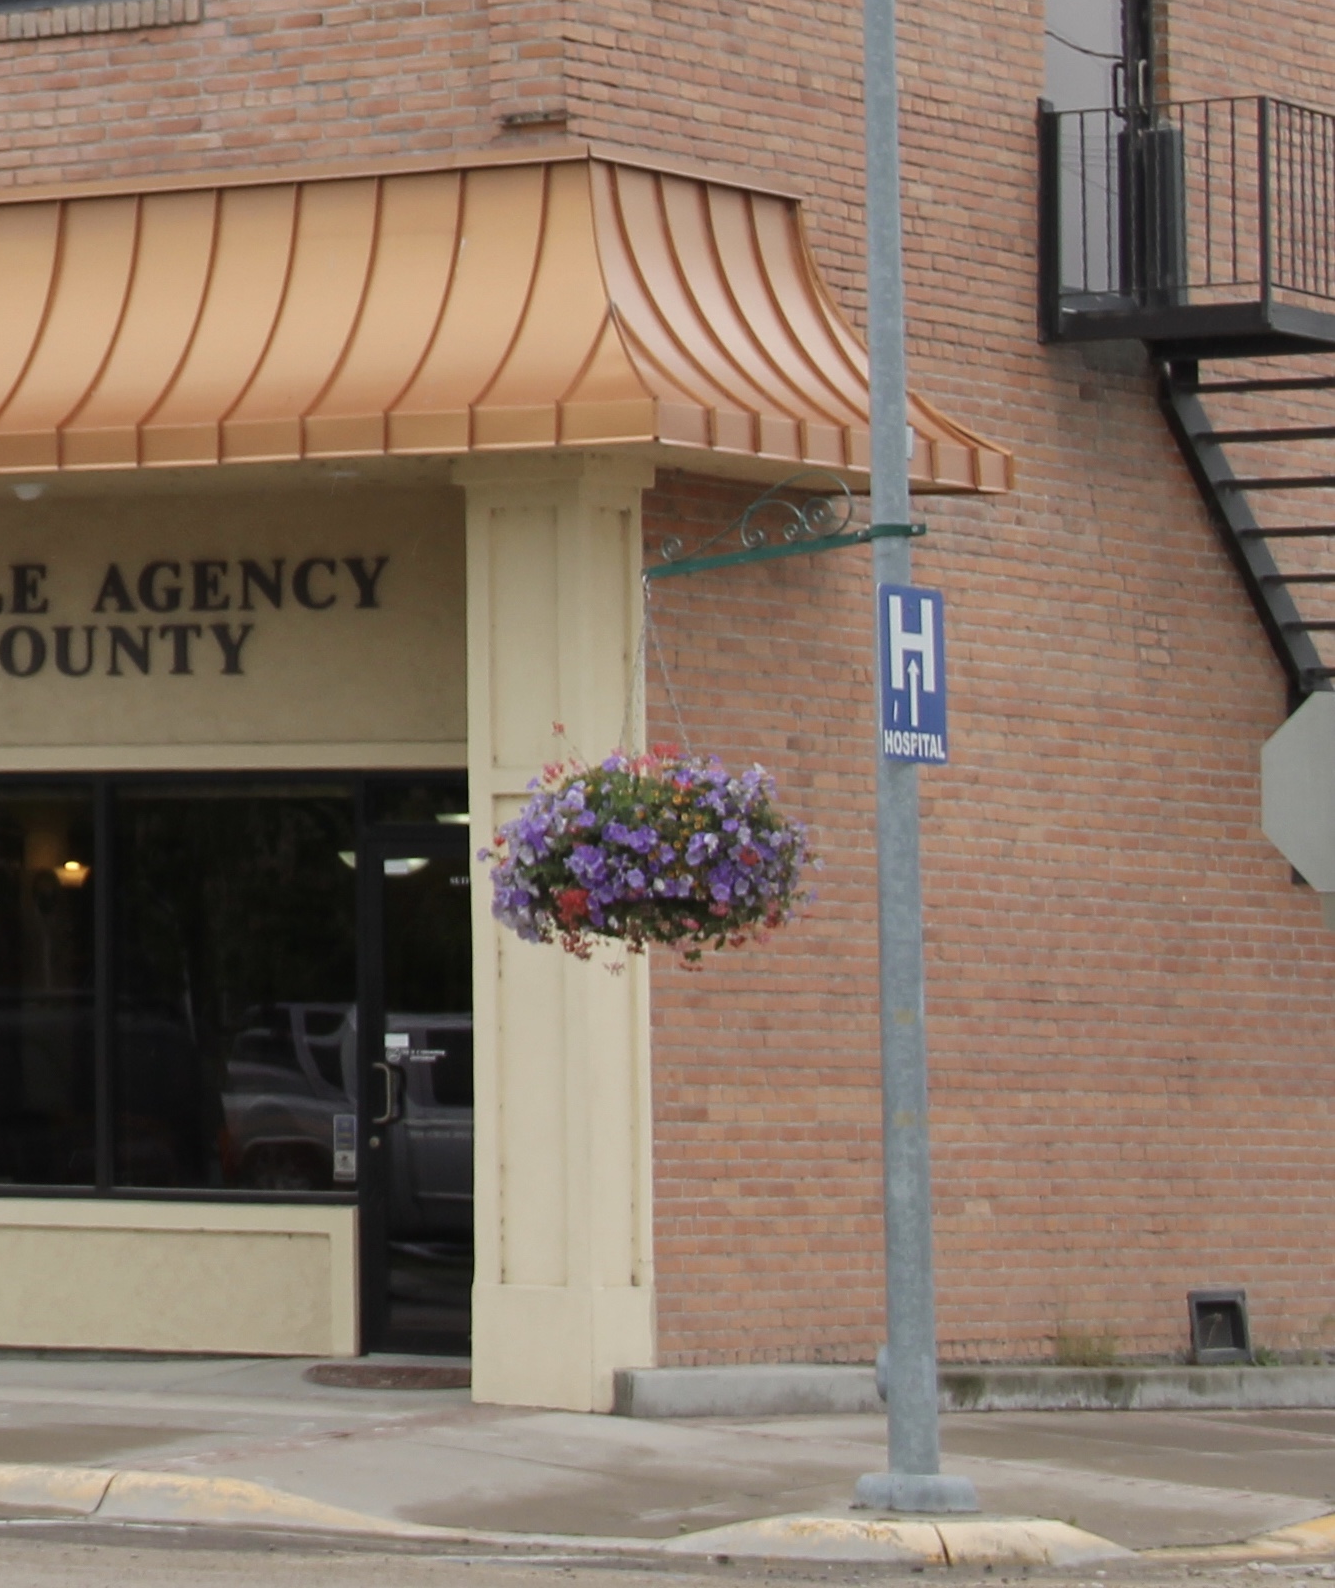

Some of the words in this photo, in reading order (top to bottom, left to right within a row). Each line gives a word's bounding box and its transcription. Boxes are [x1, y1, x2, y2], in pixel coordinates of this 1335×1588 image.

[93, 555, 389, 612] AGENCY
[888, 594, 936, 694] H
[884, 729, 946, 760] HOSPITAL
